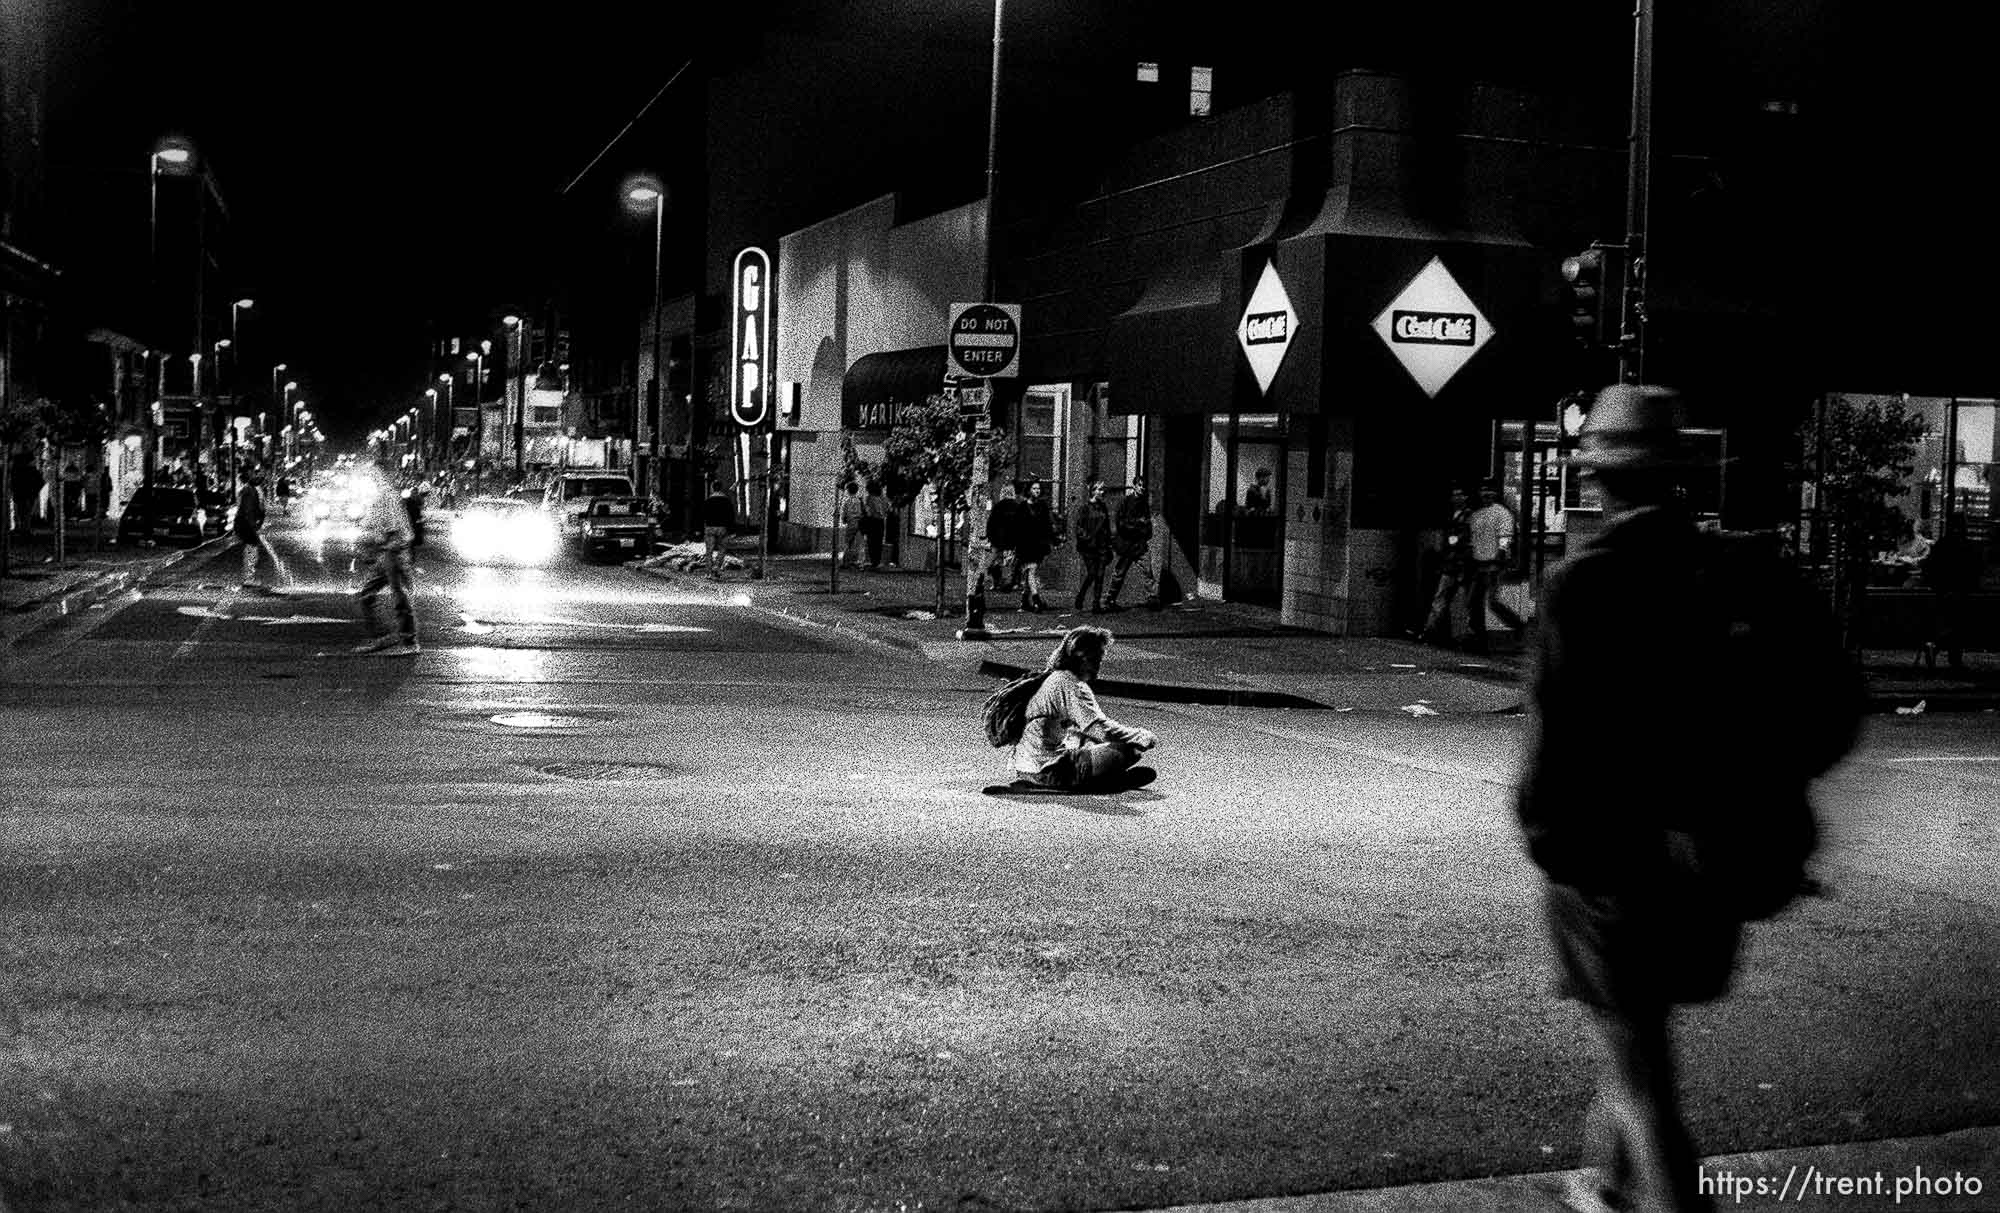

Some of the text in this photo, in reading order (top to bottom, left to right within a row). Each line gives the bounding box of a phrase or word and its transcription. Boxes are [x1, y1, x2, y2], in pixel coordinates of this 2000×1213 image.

[961, 318, 1009, 331] DO NOT
[741, 265, 760, 408] GAP
[964, 350, 1002, 362] ENTER
